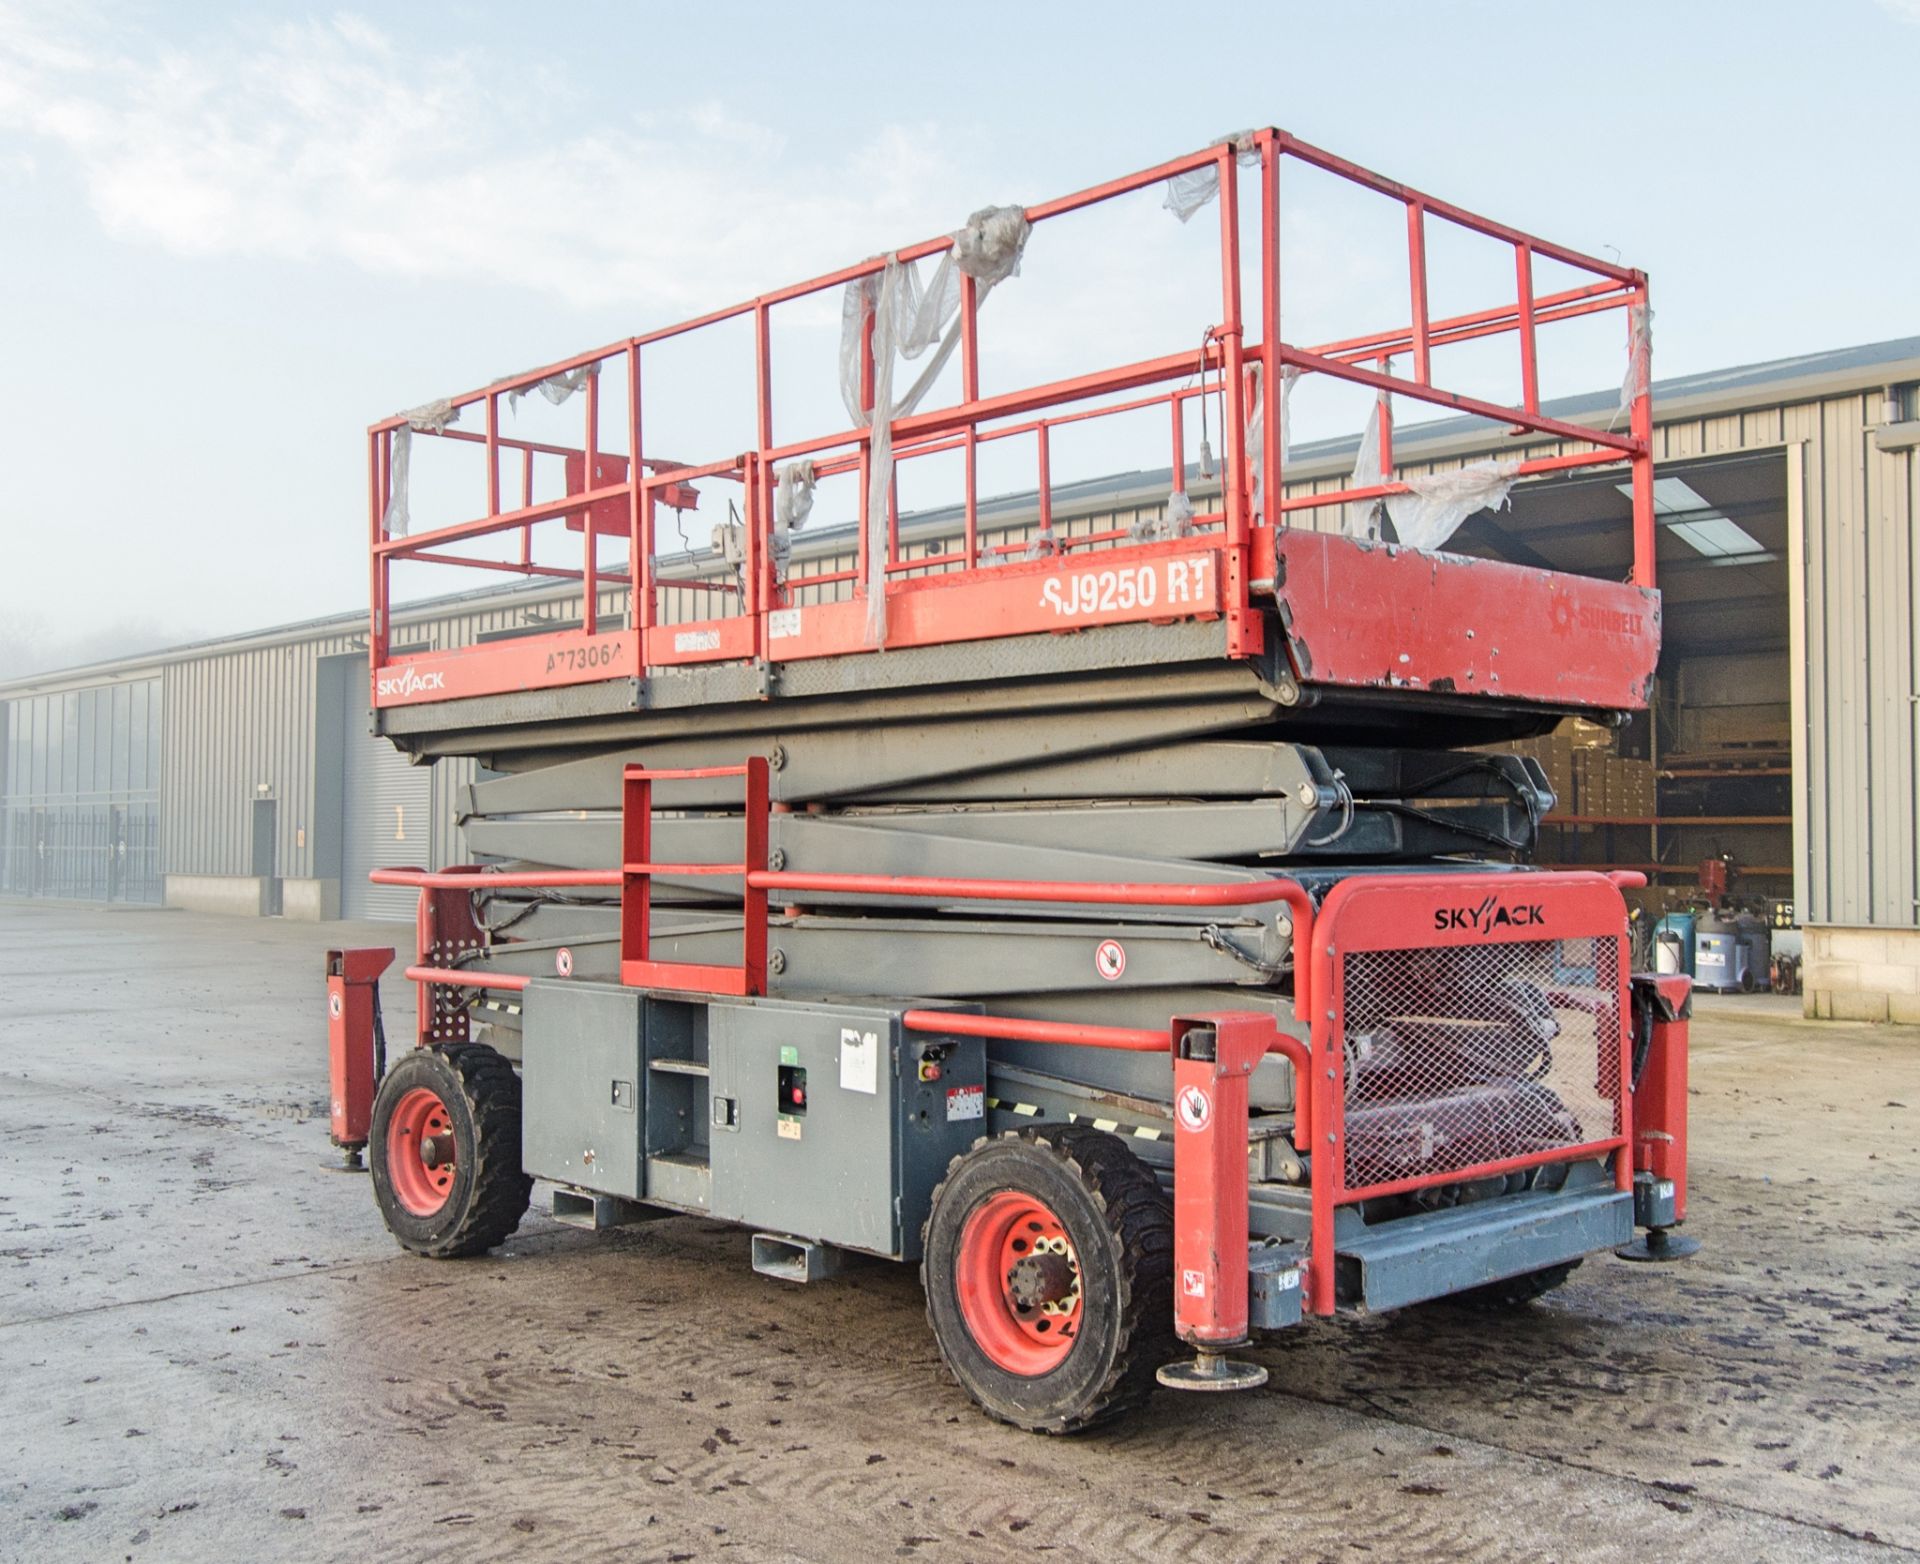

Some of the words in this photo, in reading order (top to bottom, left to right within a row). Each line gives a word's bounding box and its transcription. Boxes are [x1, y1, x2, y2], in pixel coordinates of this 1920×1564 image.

[1040, 566, 1157, 616] SJ9250
[1168, 558, 1209, 603] RT
[377, 666, 446, 697] SKYJACK
[392, 804, 406, 841] 1
[1434, 896, 1545, 935] SKYJACK
